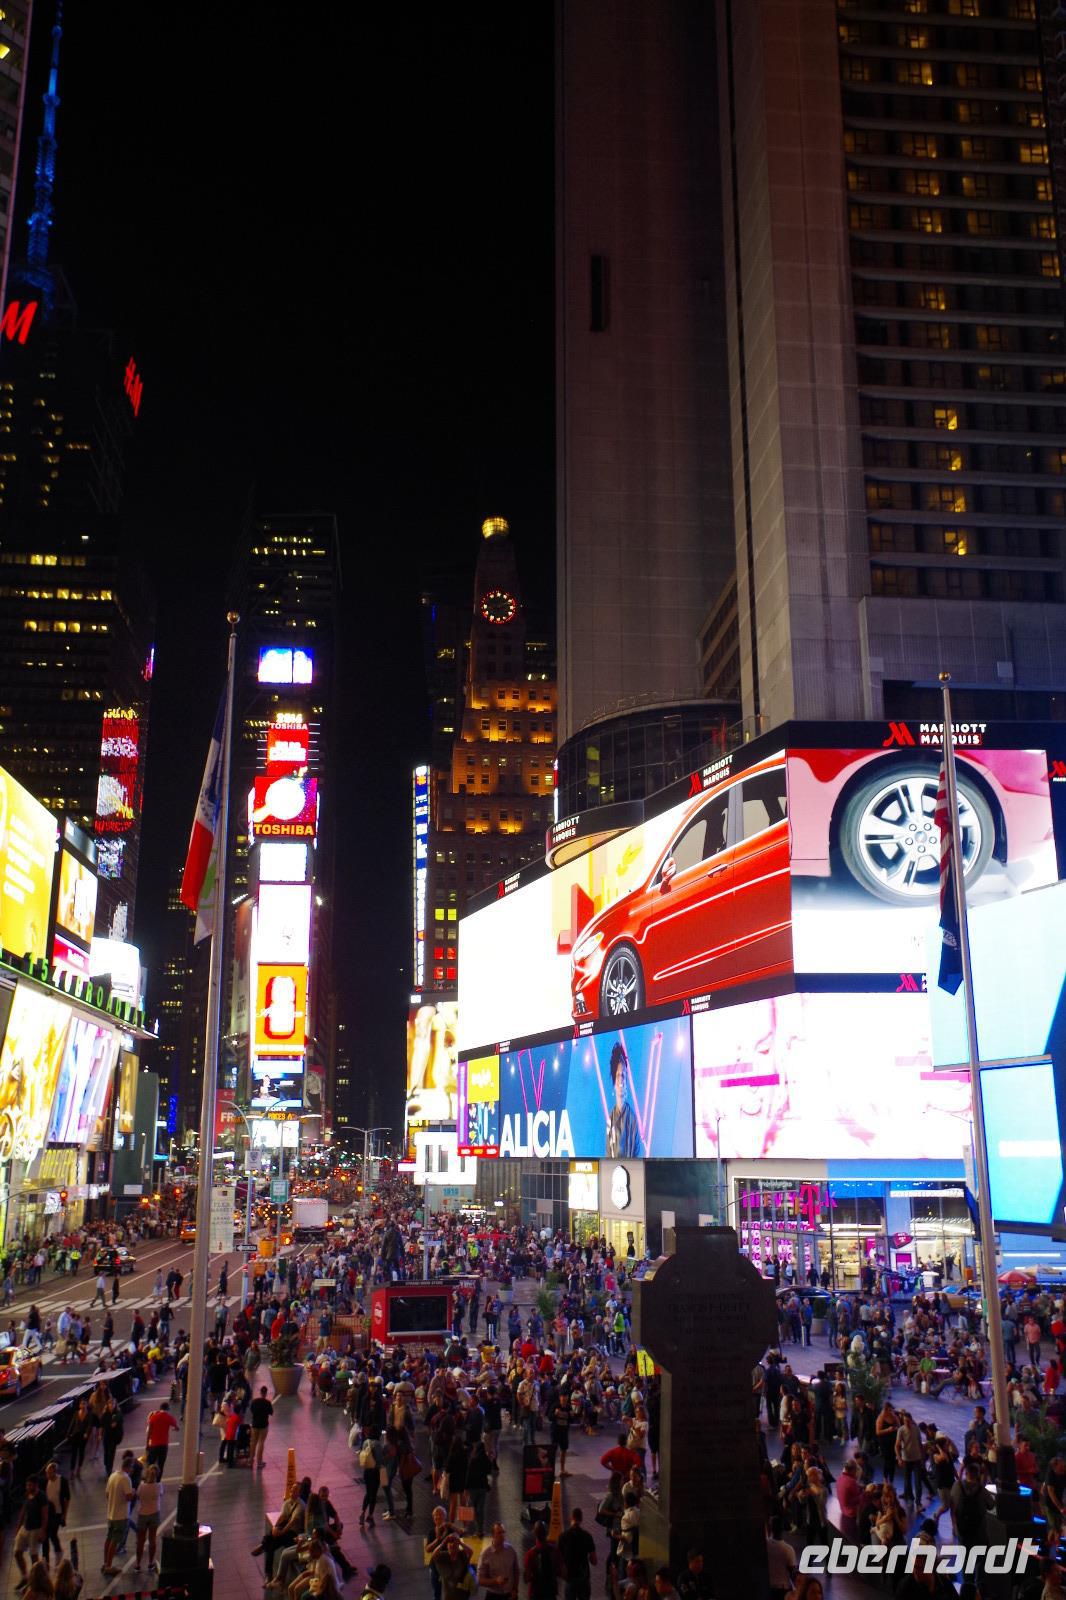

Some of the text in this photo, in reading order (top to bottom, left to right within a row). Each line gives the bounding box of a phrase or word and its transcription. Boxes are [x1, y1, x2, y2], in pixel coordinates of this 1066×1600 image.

[270, 722, 308, 730] TOSHIBA
[703, 754, 733, 777] MARRIOTT
[703, 767, 730, 788] MARQUIS
[254, 823, 314, 836] TOSHIBA
[74, 975, 146, 1027] BROADWAY
[500, 1109, 576, 1157] ALICIA
